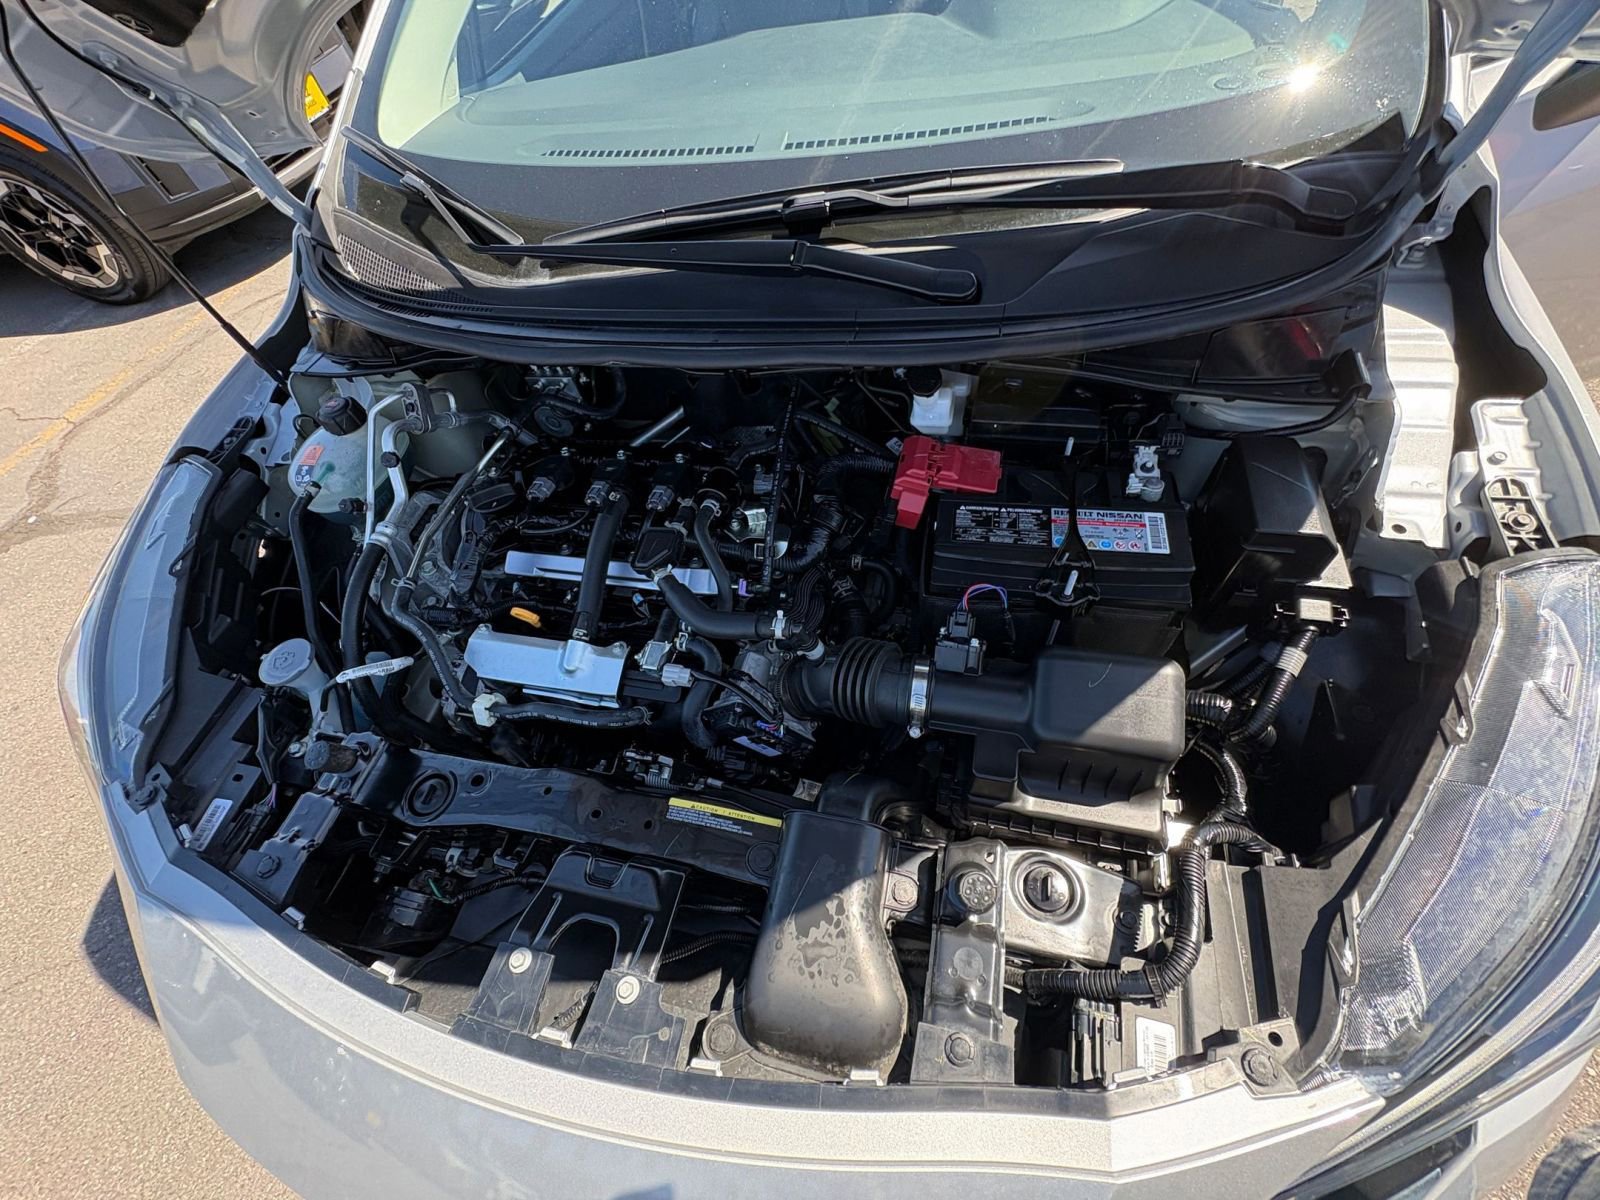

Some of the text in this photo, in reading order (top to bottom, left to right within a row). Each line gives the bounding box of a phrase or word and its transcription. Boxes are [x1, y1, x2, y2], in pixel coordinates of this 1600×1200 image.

[1054, 510, 1143, 520] REULT NISSAN
[695, 804, 718, 812] CAUTION
[728, 811, 755, 820] ATTENTION
